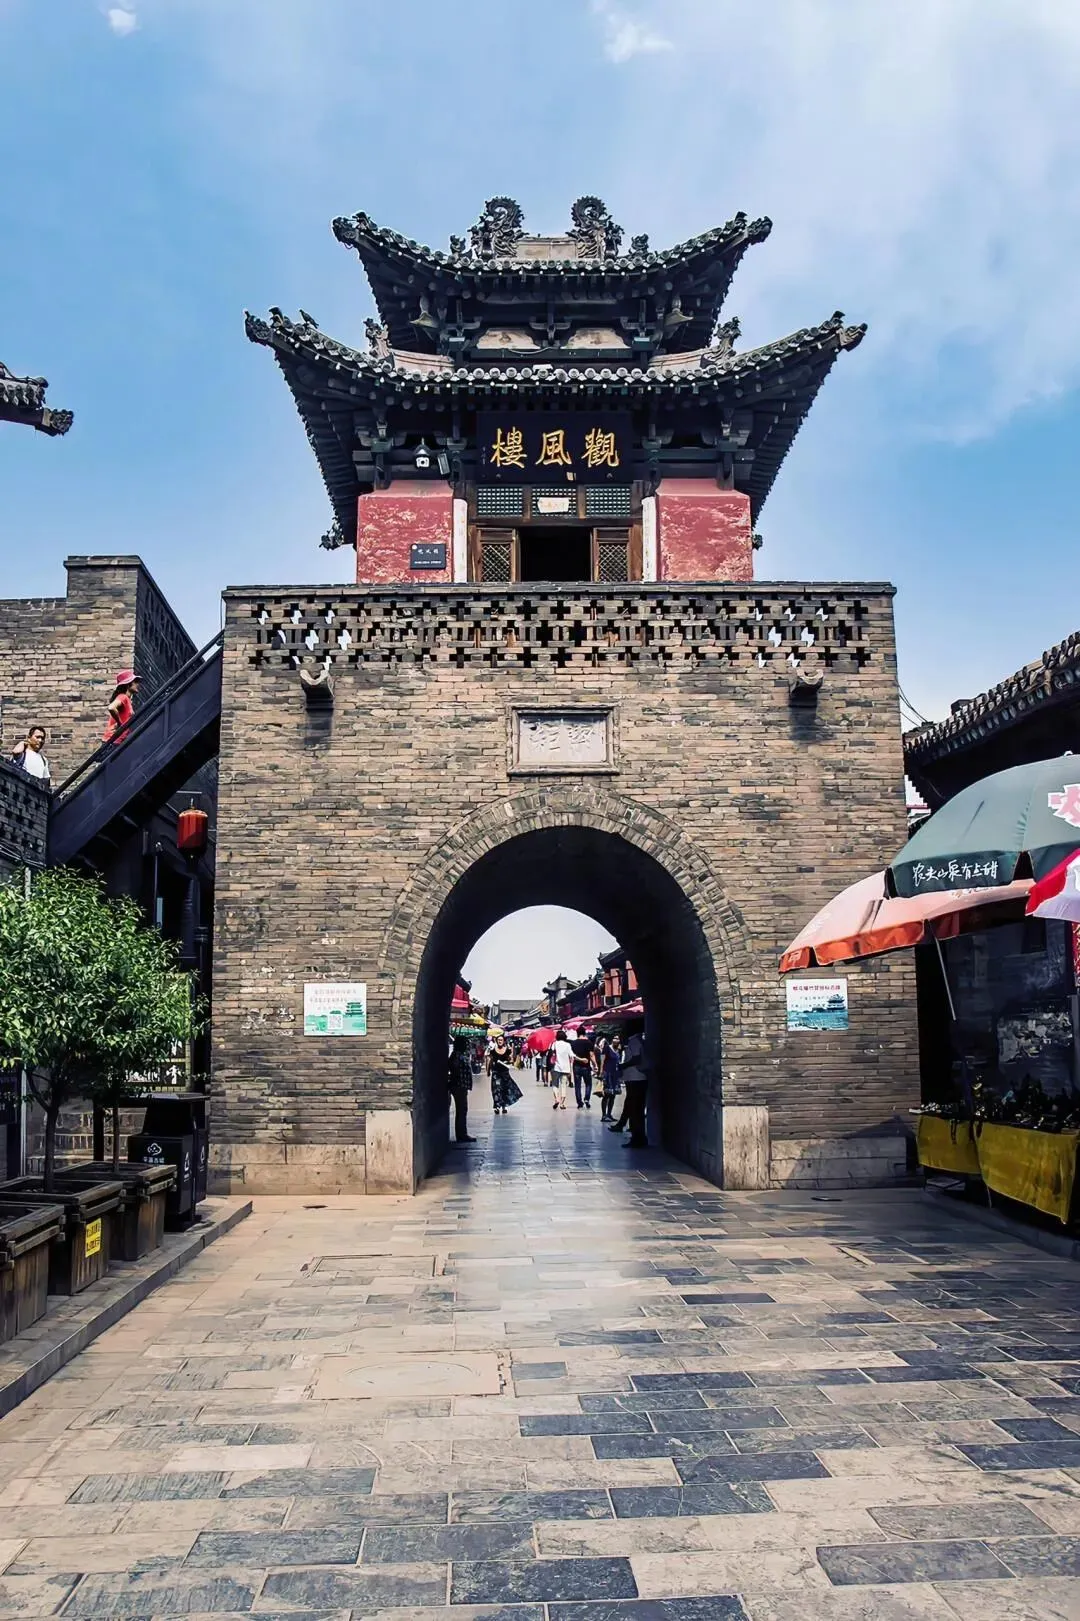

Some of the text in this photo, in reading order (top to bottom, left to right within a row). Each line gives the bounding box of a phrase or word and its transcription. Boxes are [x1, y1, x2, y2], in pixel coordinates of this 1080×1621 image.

[913, 859, 998, 886] 农夫山泉有点甜
